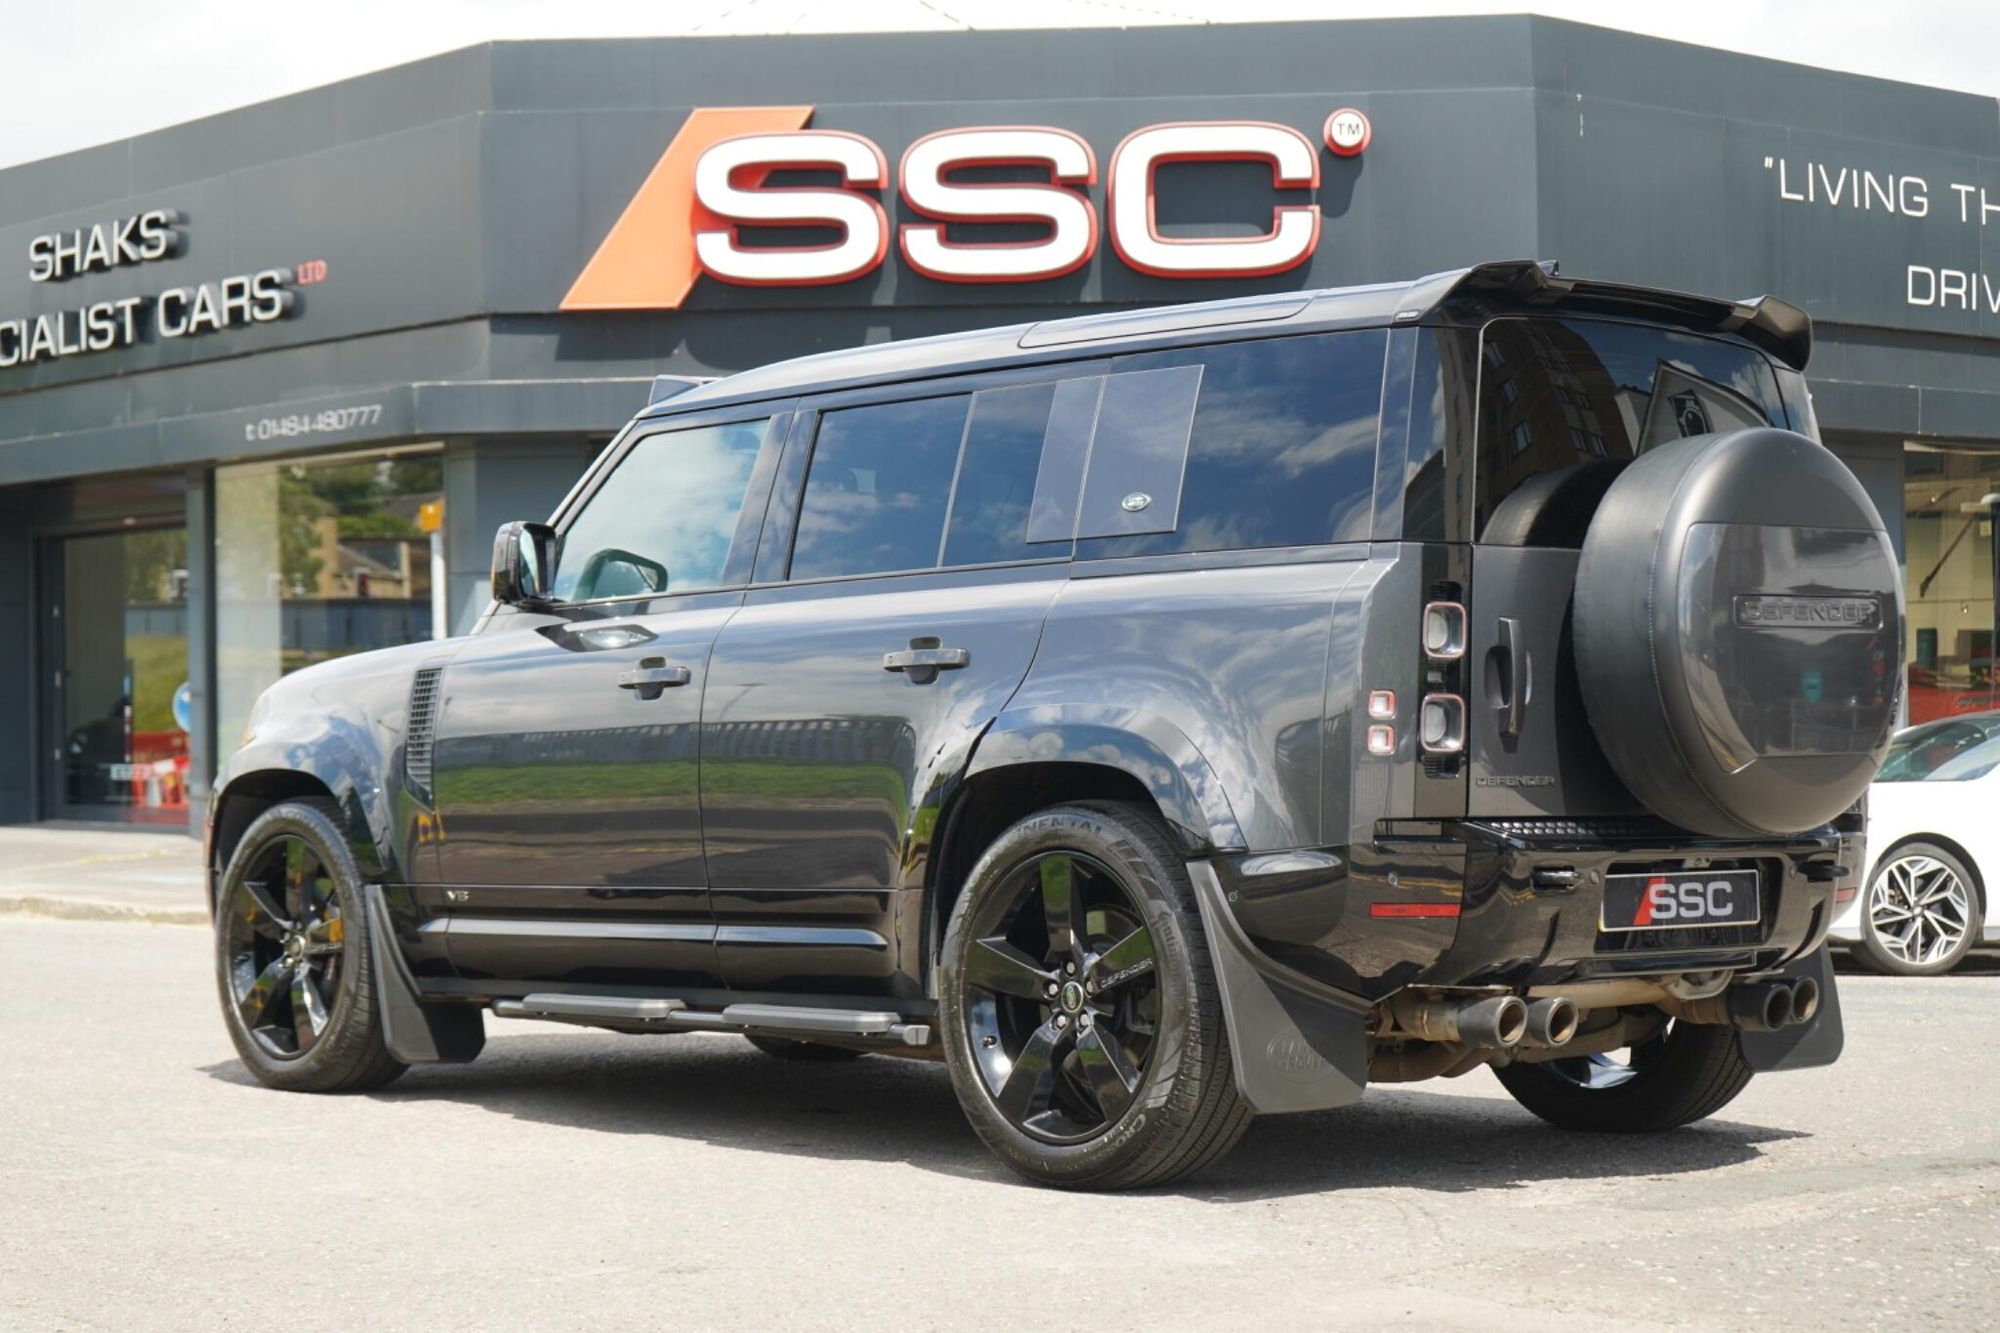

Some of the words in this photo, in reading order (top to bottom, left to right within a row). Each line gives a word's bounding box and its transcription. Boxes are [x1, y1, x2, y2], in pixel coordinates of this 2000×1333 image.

[694, 121, 1321, 285] SSC
[1335, 122, 1361, 136] TM
[28, 209, 172, 282] SHAKS
[158, 269, 284, 338] CARS
[297, 260, 327, 286] LTD
[1740, 599, 1880, 624] DEFENDER
[1476, 774, 1556, 788] DEFENDER
[1649, 880, 1733, 919] SSC
